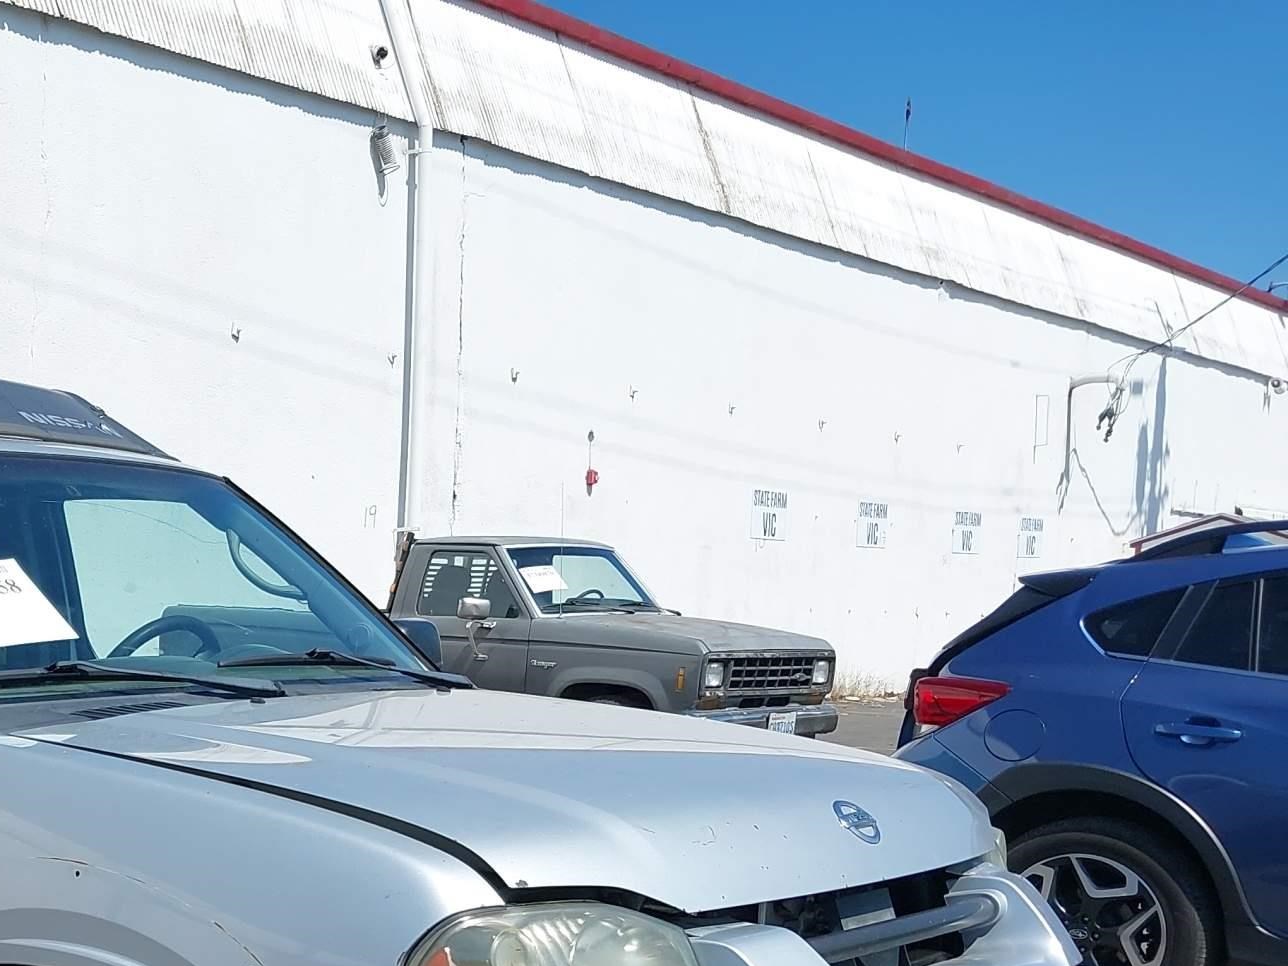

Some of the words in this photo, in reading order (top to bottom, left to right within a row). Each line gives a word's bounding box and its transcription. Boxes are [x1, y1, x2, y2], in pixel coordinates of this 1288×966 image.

[753, 489, 770, 508] STATE
[770, 491, 788, 509] FARM
[859, 501, 873, 519] STATE
[873, 502, 889, 519] FARM
[762, 511, 777, 538] VIC
[866, 522, 879, 546] VIC
